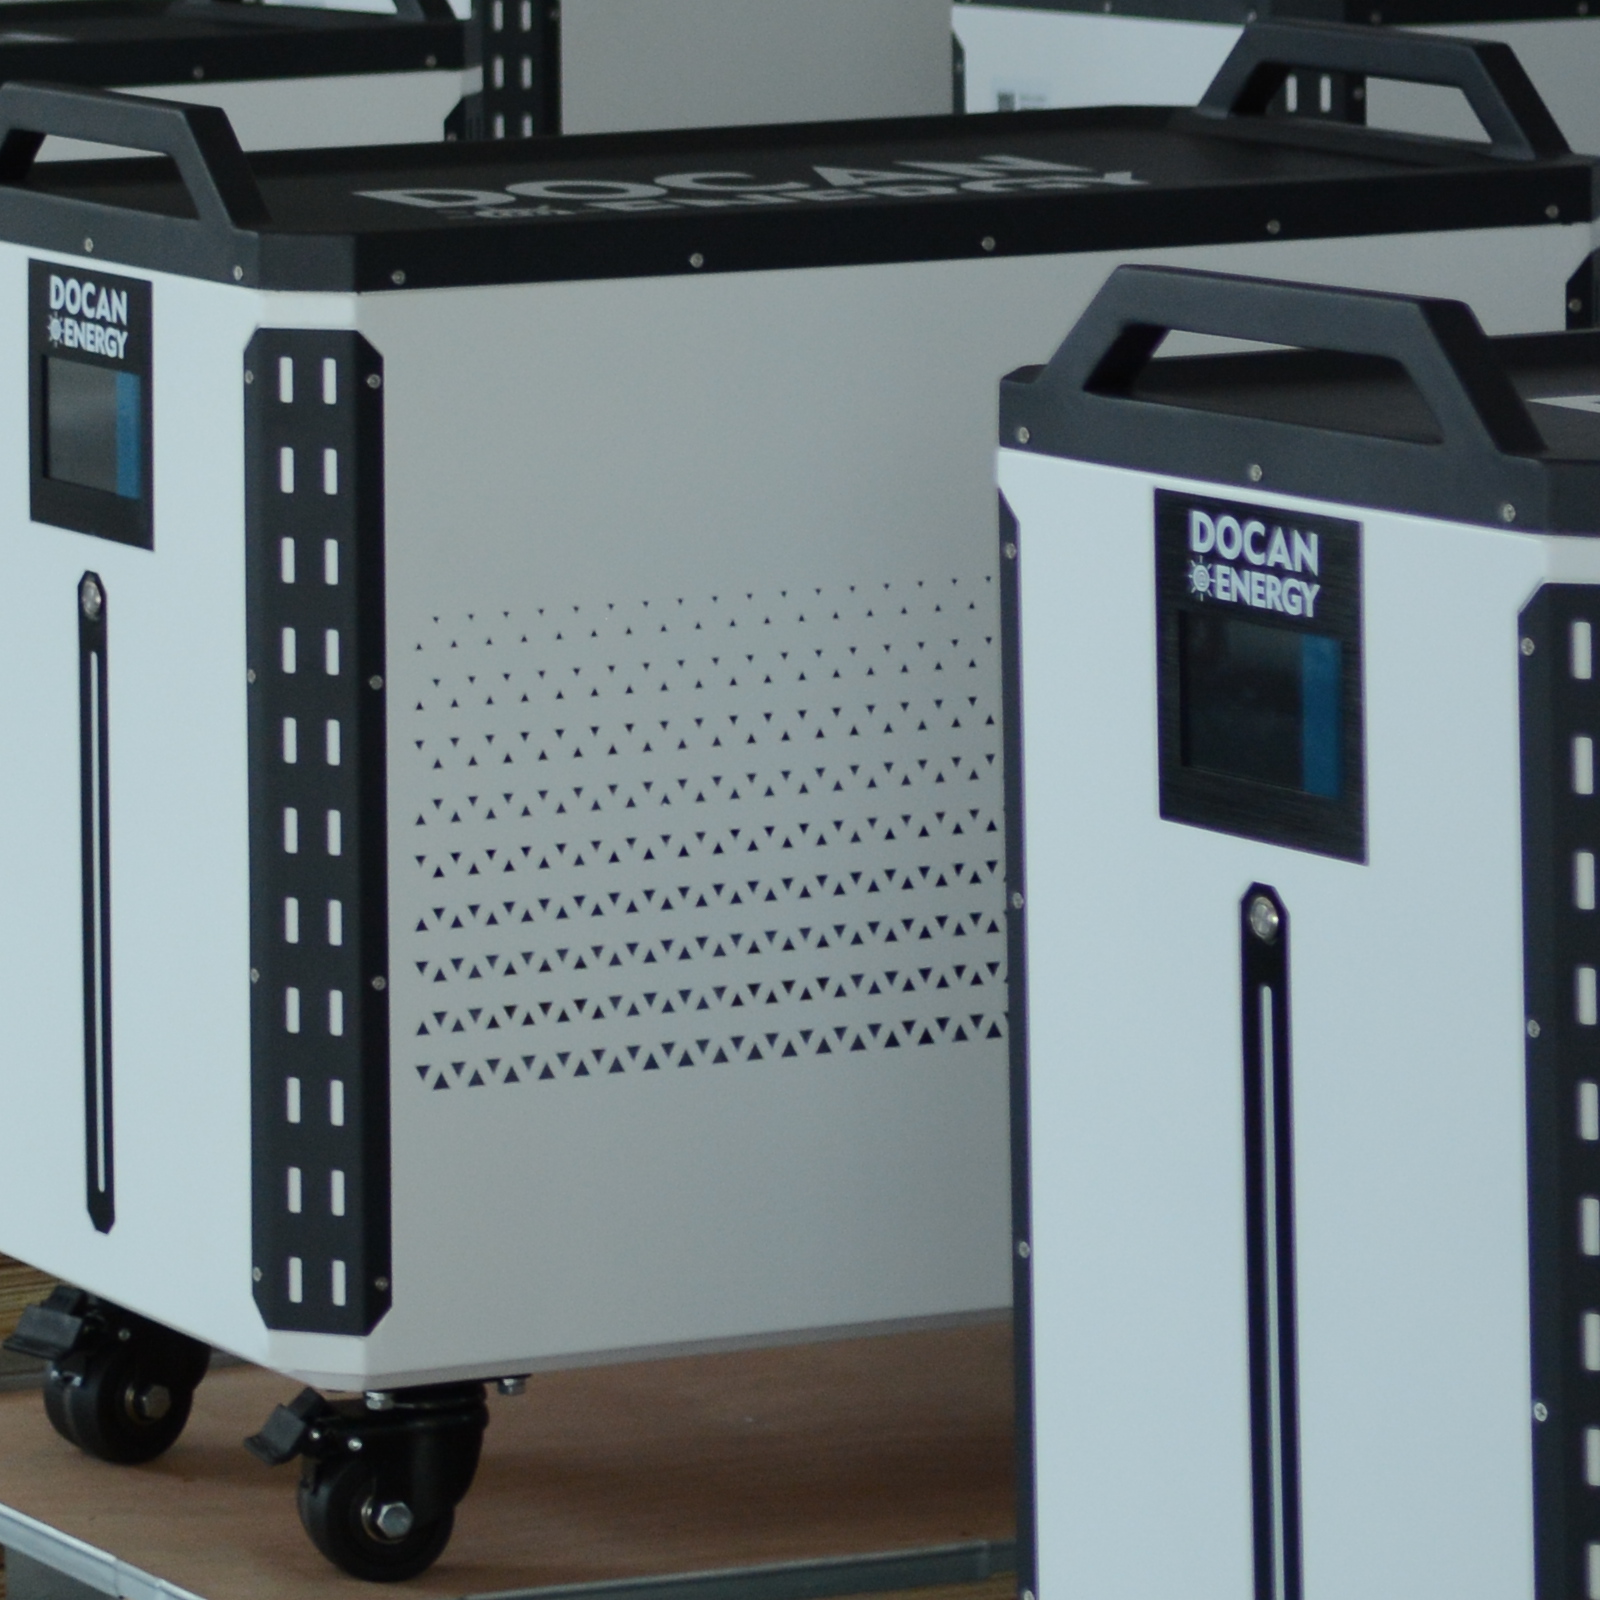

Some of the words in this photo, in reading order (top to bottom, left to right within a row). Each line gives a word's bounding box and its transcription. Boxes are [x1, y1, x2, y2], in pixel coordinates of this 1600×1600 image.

[352, 154, 1098, 208] DOCAN
[50, 274, 128, 326] DOCAN
[64, 317, 128, 359] ENERGY
[1189, 510, 1319, 577] DOCAN
[1215, 565, 1321, 618] ENERGY
